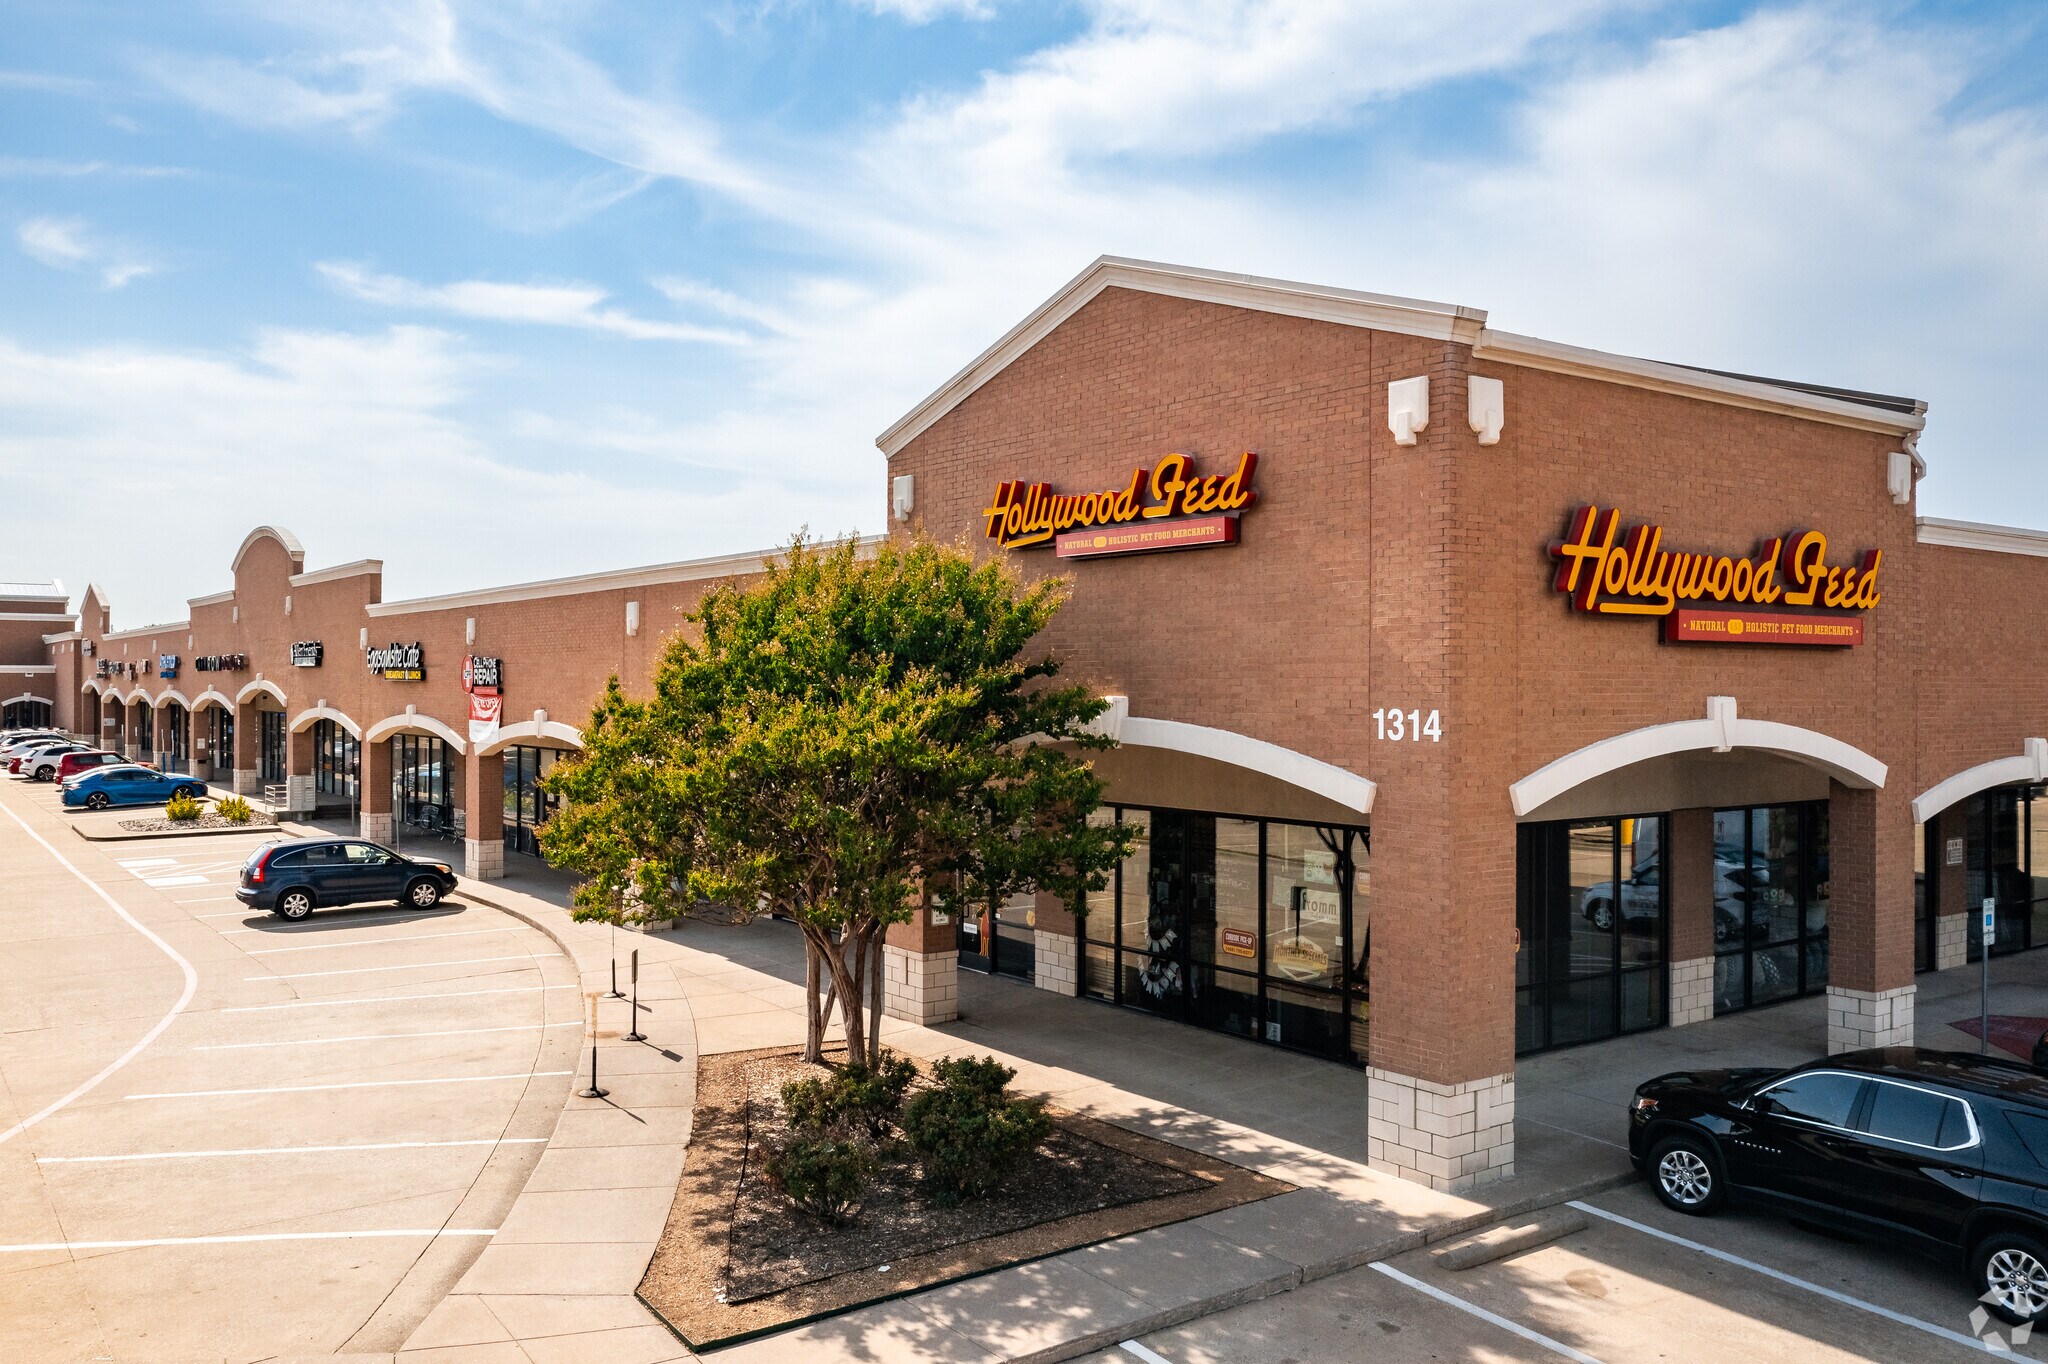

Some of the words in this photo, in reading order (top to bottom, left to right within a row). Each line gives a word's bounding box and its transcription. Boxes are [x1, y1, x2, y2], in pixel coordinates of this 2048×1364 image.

[982, 468, 1140, 550] Hollywood
[1142, 452, 1249, 518] Feed
[1064, 539, 1092, 550] NATURAL
[1108, 533, 1138, 545] HOLISTIC
[1140, 532, 1154, 542] PET
[1154, 530, 1171, 540] FOOD
[1172, 526, 1215, 539] MERCHANTS
[1561, 505, 1782, 615] Hollywood
[1784, 530, 1883, 609] Feed
[1690, 620, 1726, 632] NATURAL
[1745, 622, 1780, 634] HOLISTIC
[1781, 623, 1795, 634] PET
[1796, 623, 1813, 635] FOOD
[1814, 624, 1854, 636] MERCHANTS
[473, 668, 498, 685] REPAIR
[1372, 708, 1442, 743] 1314
